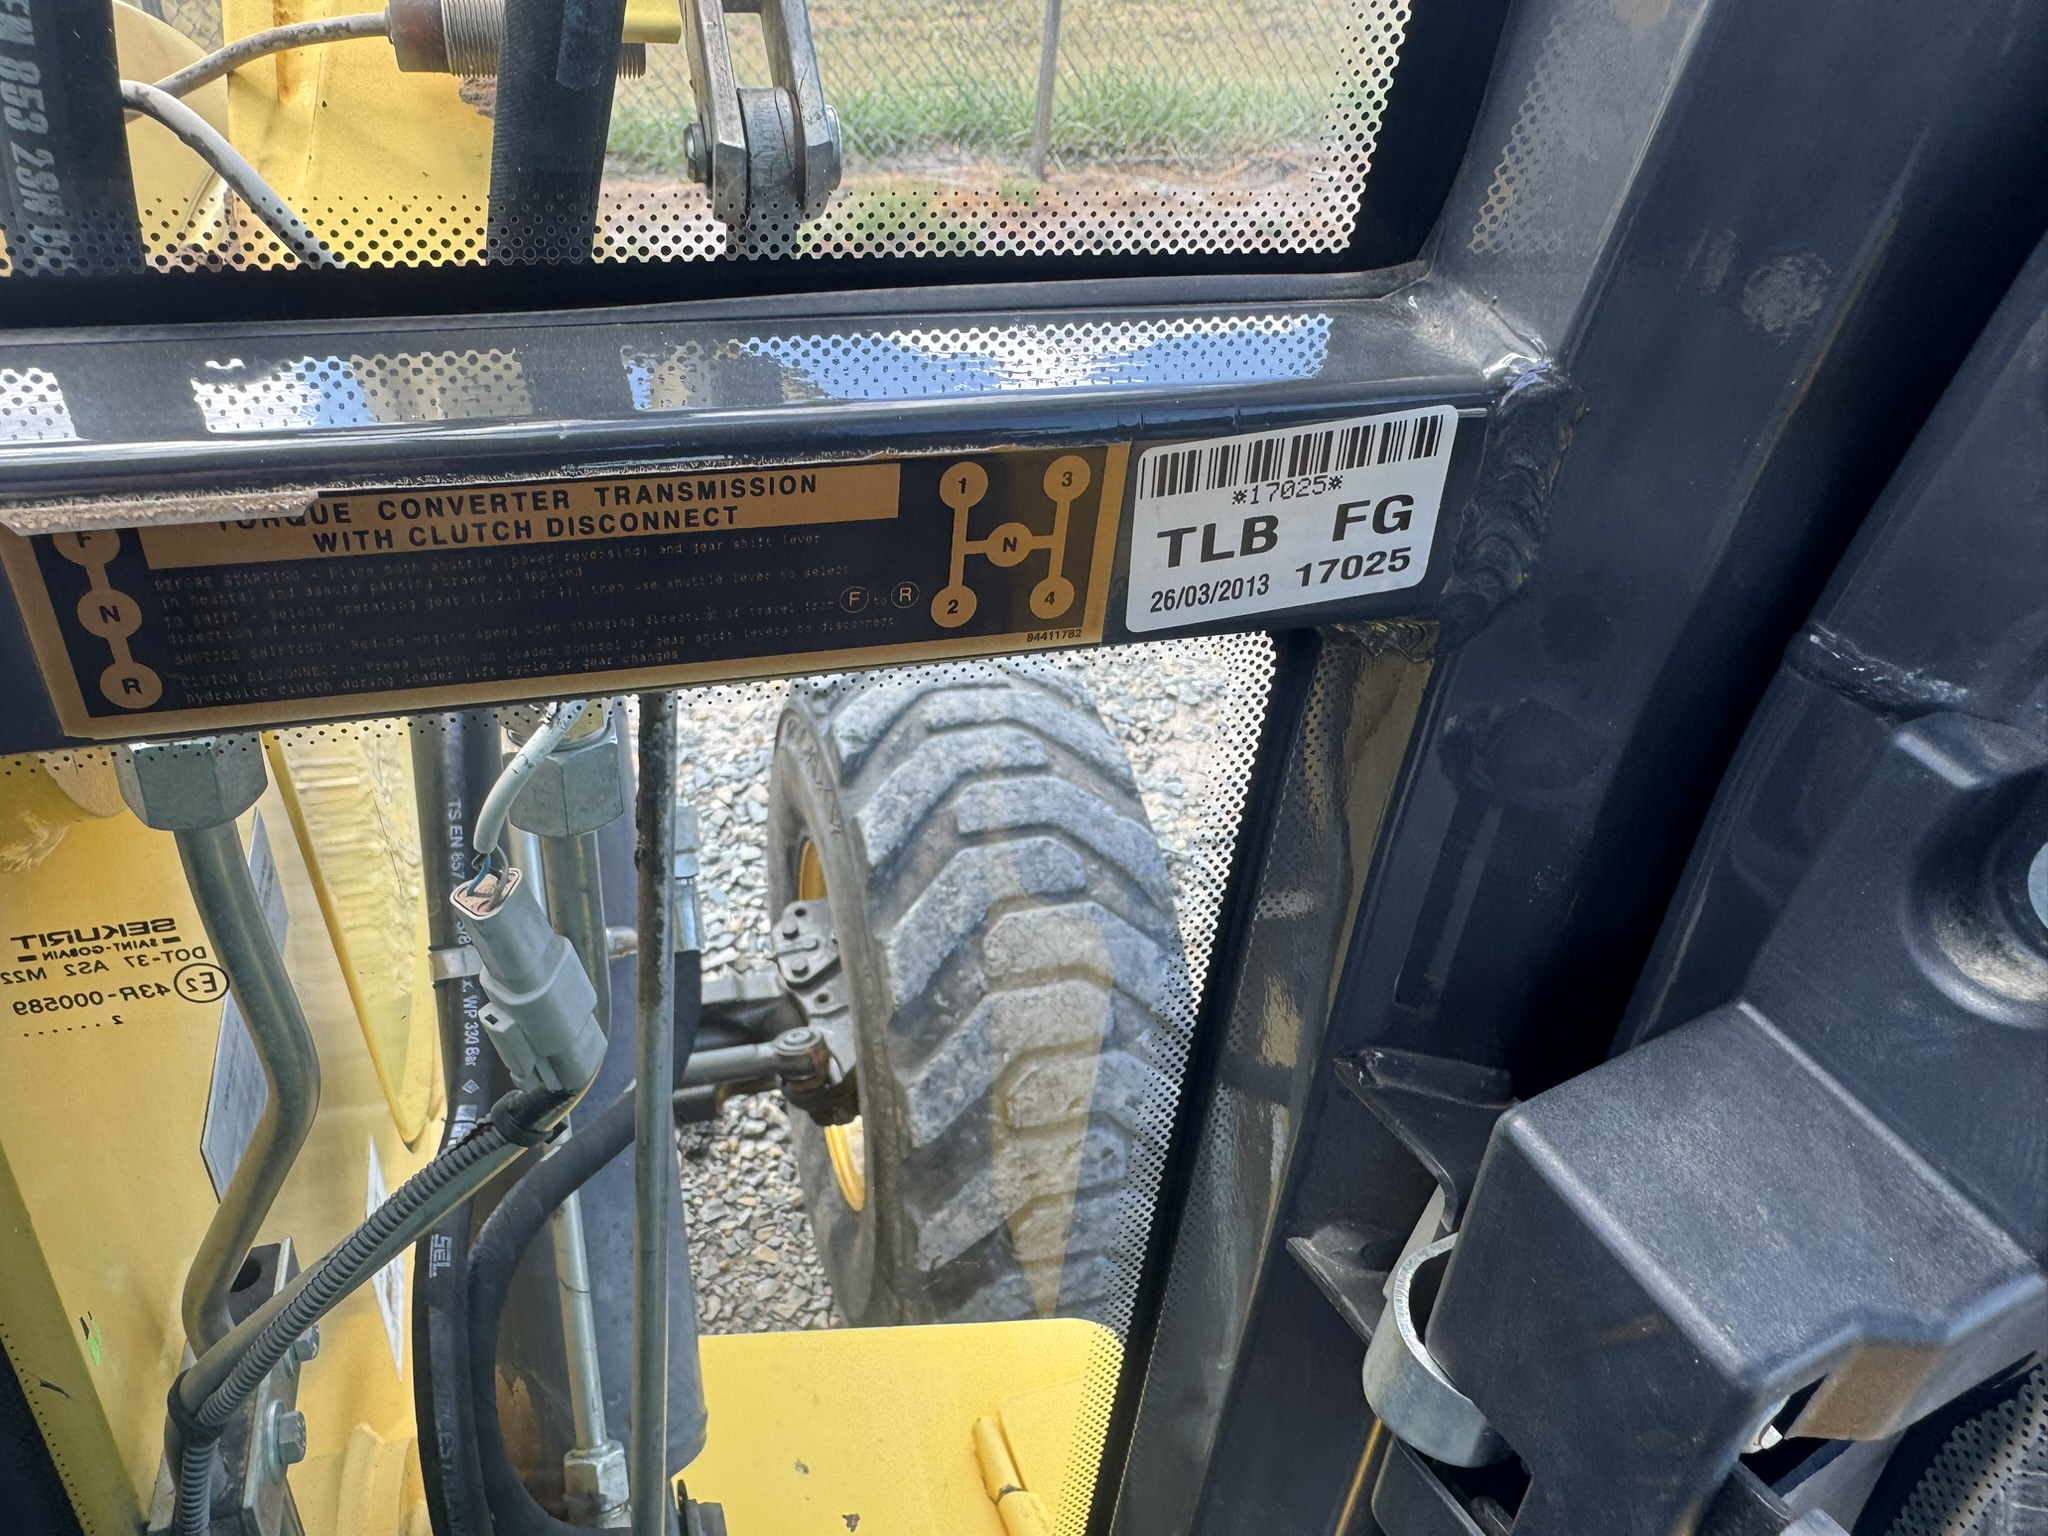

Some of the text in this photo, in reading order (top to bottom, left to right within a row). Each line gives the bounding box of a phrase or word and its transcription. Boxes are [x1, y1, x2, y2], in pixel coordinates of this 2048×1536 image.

[0, 55, 48, 134] 853
[957, 471, 1073, 494] 1 3
[377, 489, 569, 520] CONVERTER
[594, 474, 817, 507] TRANSMISSION
[312, 506, 738, 553] WITH CLUTCH DISCONNECT
[1156, 493, 1415, 569] TLB FG
[1003, 537, 1018, 552] N
[1150, 546, 1412, 613] 26/03/2013 17025
[946, 598, 959, 614] 2
[1044, 590, 1056, 606] 4
[99, 604, 121, 624] N
[121, 677, 143, 695] R
[448, 797, 462, 821] TS
[450, 825, 464, 848] EN
[450, 851, 466, 880] 857
[463, 995, 478, 1019] WP
[464, 1021, 480, 1045] 330
[465, 1046, 480, 1067] Bar
